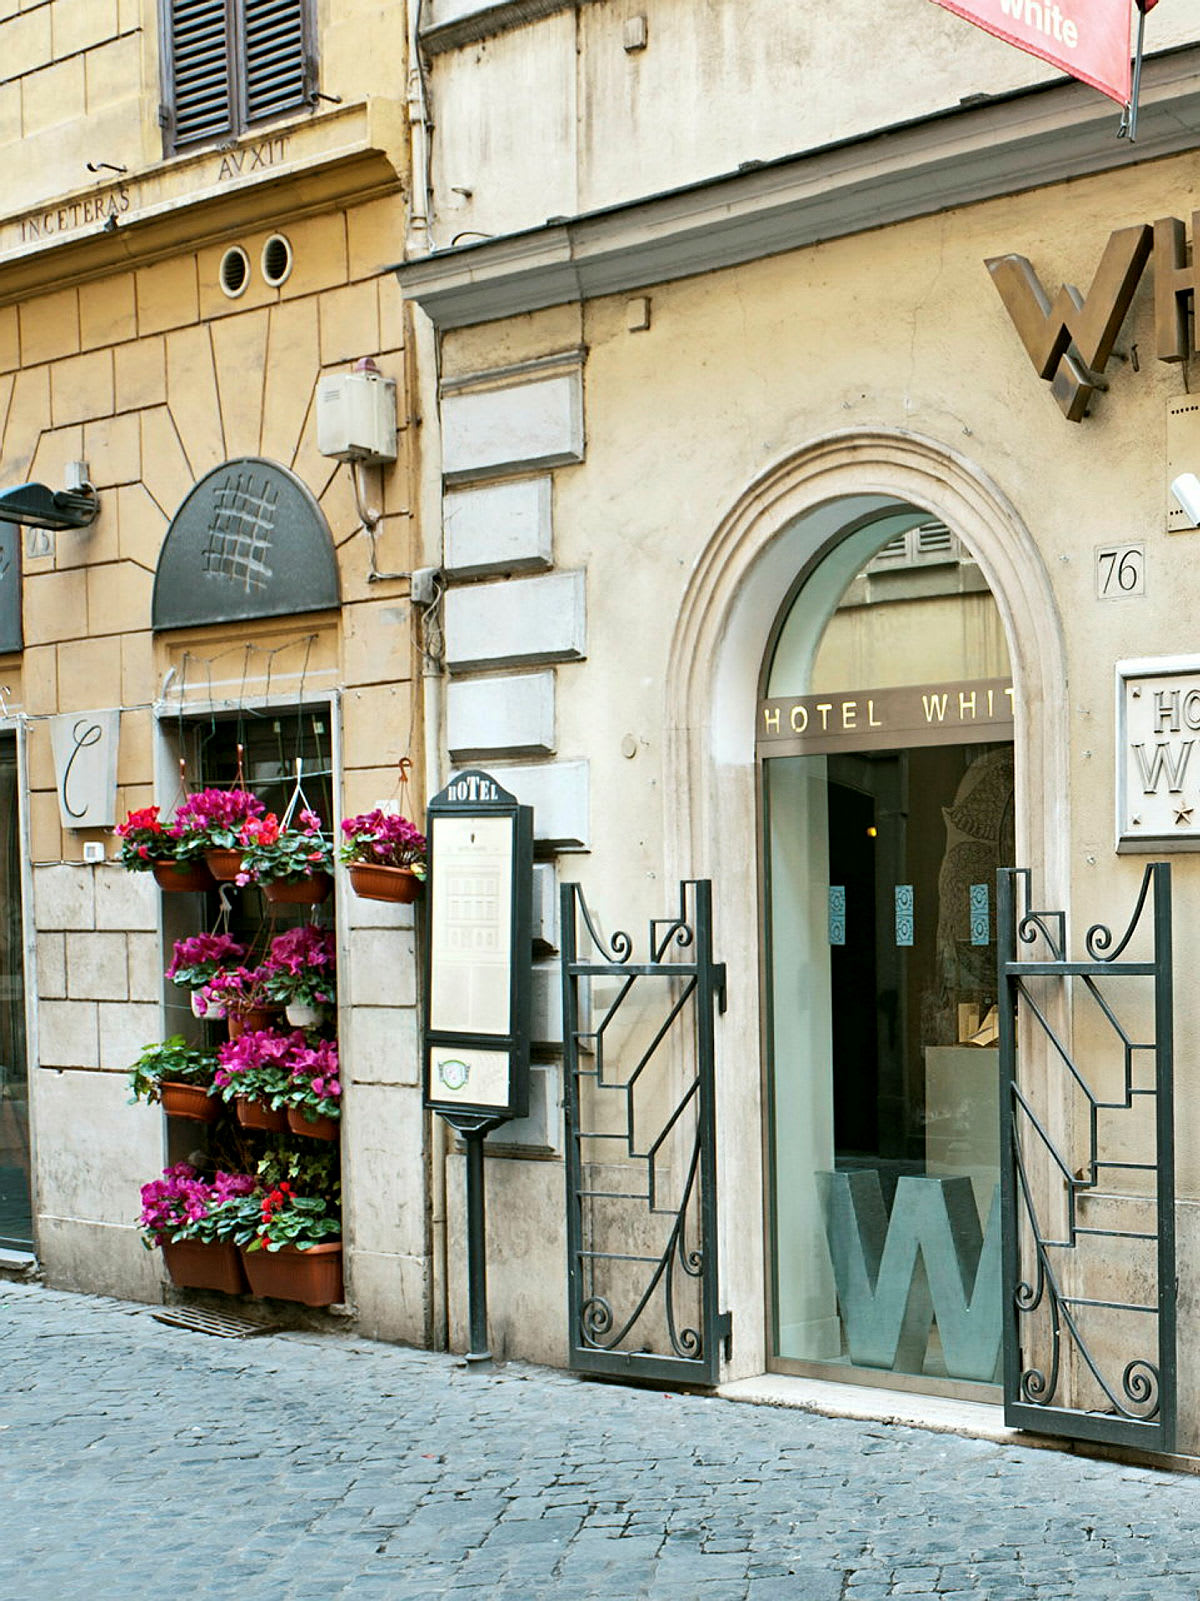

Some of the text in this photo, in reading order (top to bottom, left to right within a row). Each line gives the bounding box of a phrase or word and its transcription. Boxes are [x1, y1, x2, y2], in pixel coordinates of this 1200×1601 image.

[217, 137, 290, 181] AVXIT
[1098, 549, 1142, 594] 76
[764, 700, 883, 734] HOTEL
[448, 776, 499, 801] HOTEL
